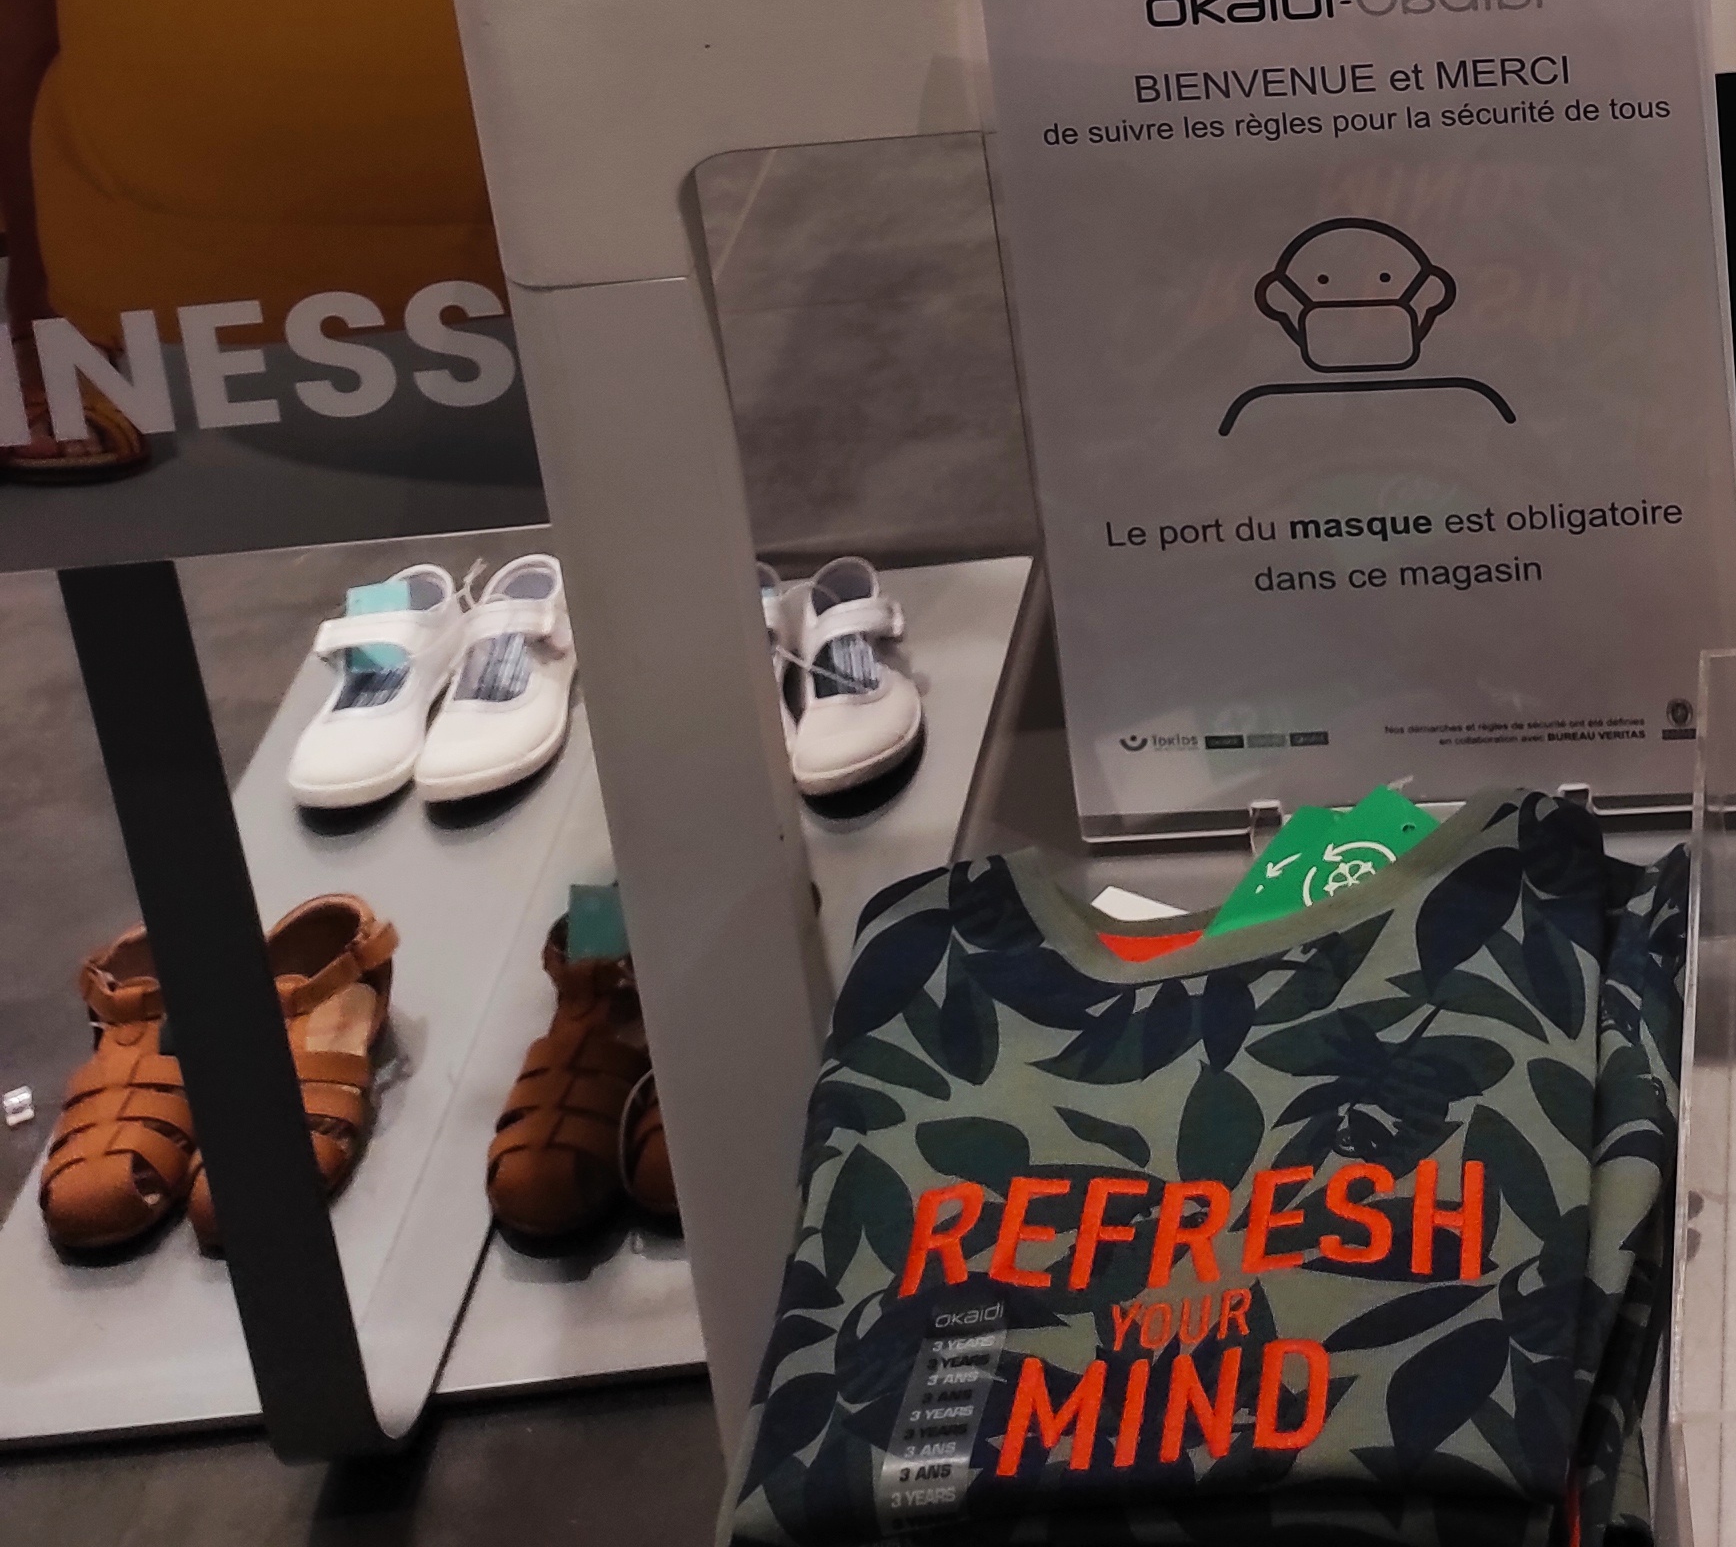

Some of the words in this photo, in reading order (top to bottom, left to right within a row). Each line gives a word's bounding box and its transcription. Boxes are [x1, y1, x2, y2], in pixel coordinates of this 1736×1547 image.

[1133, 63, 1377, 105] BIENVENUE
[1388, 63, 1426, 93] et
[1434, 55, 1571, 91] MERCI
[1042, 121, 1080, 147] de
[1088, 114, 1175, 145] suivre
[1183, 113, 1226, 140] les
[1233, 110, 1326, 143] règles
[1331, 108, 1398, 139] pour
[1404, 104, 1433, 130] la
[1439, 99, 1556, 130] sécurité
[1563, 97, 1601, 124] de
[1609, 96, 1672, 121] tous
[1104, 520, 1147, 548] Le
[1158, 516, 1226, 552] port
[1234, 515, 1278, 543] du
[1288, 511, 1434, 544] masque
[1443, 506, 1498, 536] est
[1505, 499, 1685, 537] obligatoire
[1253, 565, 1337, 593] dans
[1346, 566, 1389, 590] ce
[1398, 555, 1544, 592] magasin
[1407, 723, 1463, 735] démarches
[1465, 722, 1477, 733] et
[1478, 721, 1510, 733] règles
[1511, 720, 1526, 731] de
[1527, 718, 1568, 730] sécurité
[1605, 716, 1646, 727] définies
[1439, 737, 1453, 746] en
[1521, 733, 1545, 743] avec
[1547, 730, 1597, 743] BUREAU
[1599, 729, 1646, 741] VERITAS
[897, 1156, 1486, 1301] REFRESH
[1110, 1285, 1254, 1353] YOUR
[932, 1340, 944, 1353] 3
[946, 1335, 996, 1351] YEARS
[927, 1373, 940, 1387] 3
[942, 1370, 980, 1385] ANS
[909, 1409, 922, 1422] 3
[924, 1405, 975, 1420] YEARS
[995, 1337, 1332, 1478] MIND
[903, 1445, 916, 1459] 3
[920, 1441, 957, 1457] ANS
[898, 1467, 912, 1483] 3
[914, 1462, 953, 1482] ANS
[890, 1492, 903, 1509] 3
[904, 1487, 957, 1507] YEARS
